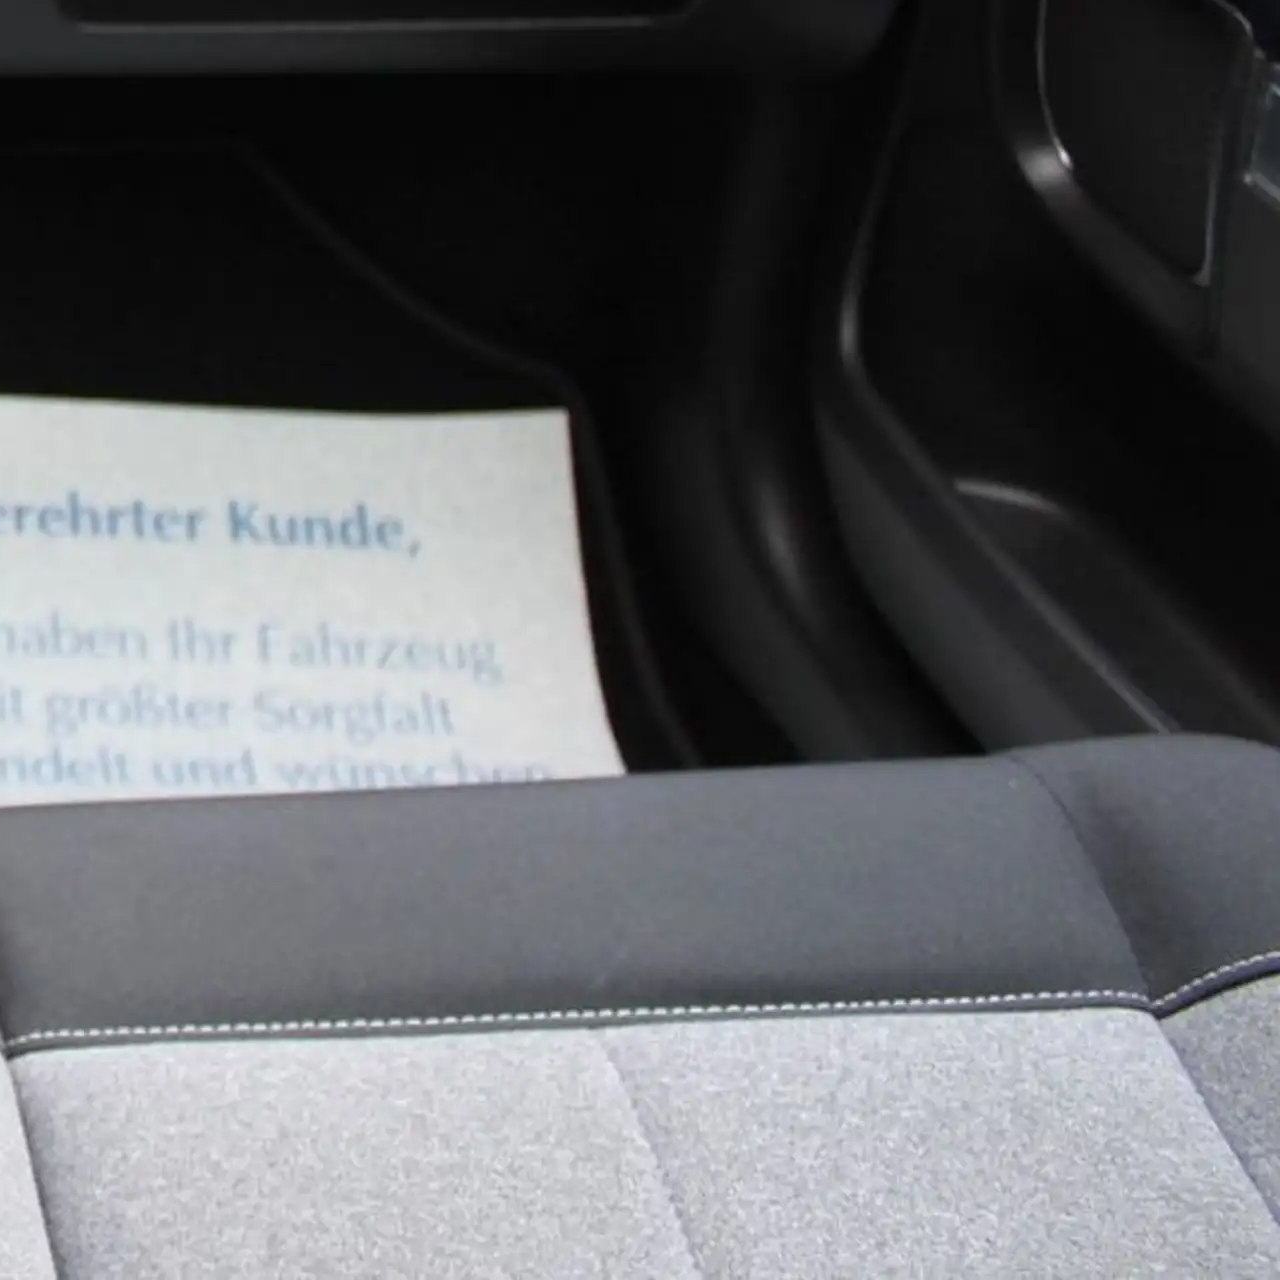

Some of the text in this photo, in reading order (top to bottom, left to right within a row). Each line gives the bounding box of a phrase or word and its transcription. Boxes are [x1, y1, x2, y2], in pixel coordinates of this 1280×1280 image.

[227, 499, 421, 559] Kunde,
[168, 616, 236, 665] Ihr
[256, 620, 504, 683] Fahrzeug
[44, 680, 233, 736] größter
[253, 690, 455, 748] Sorgfalt
[152, 747, 259, 789] und
